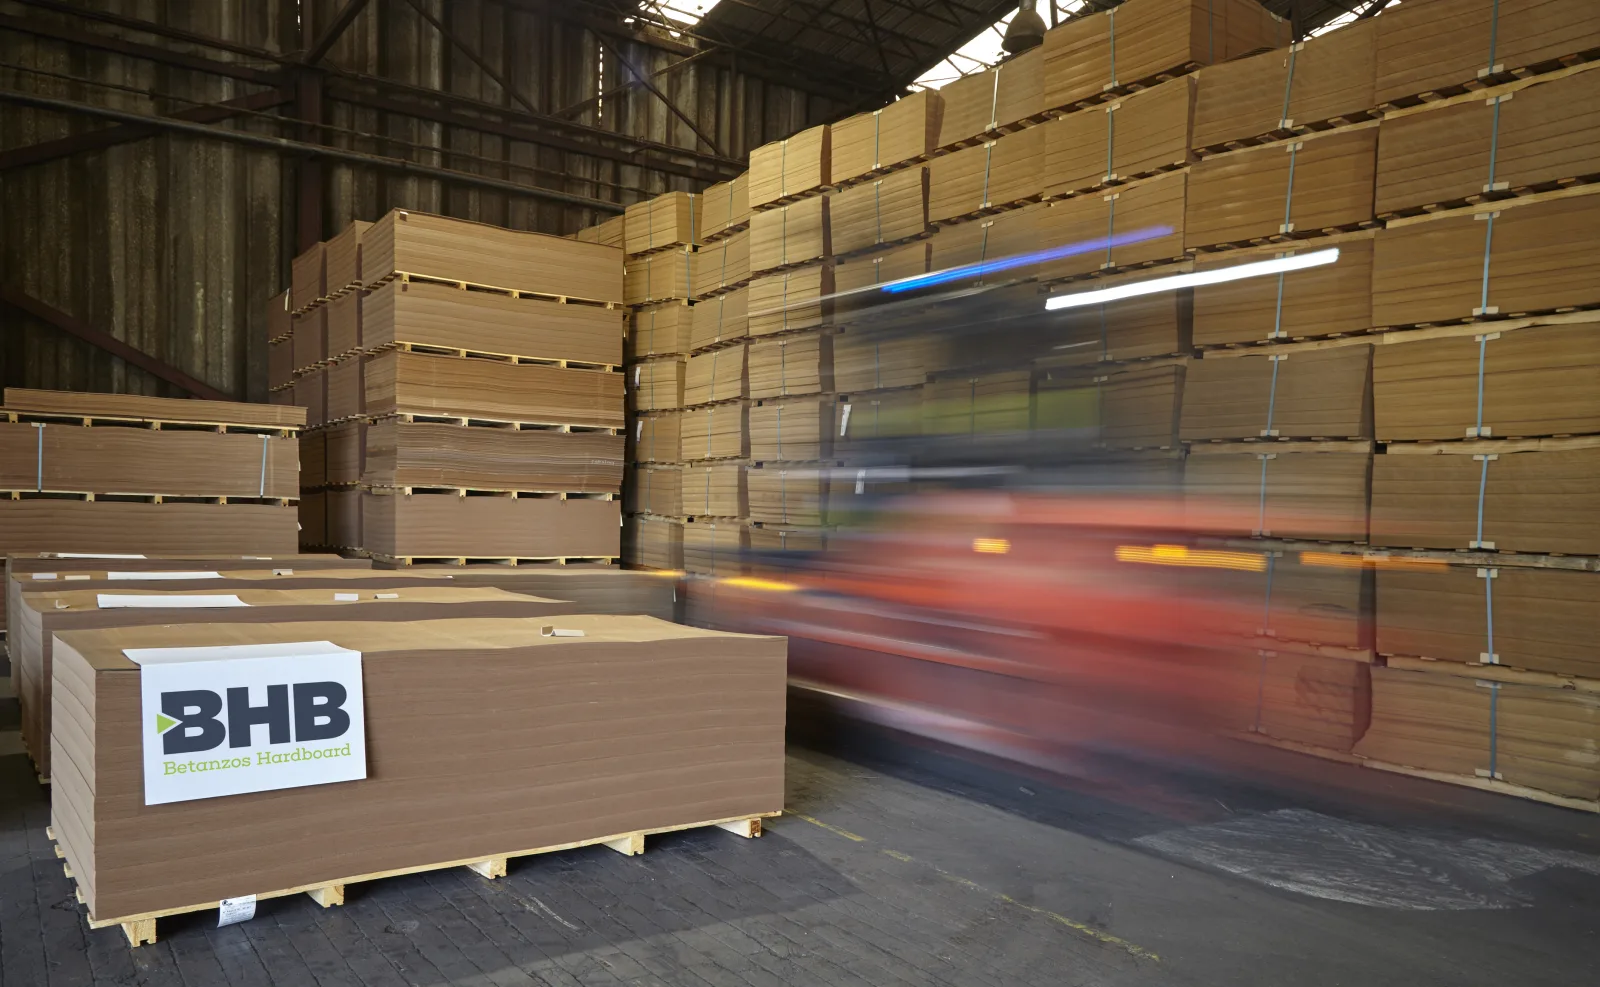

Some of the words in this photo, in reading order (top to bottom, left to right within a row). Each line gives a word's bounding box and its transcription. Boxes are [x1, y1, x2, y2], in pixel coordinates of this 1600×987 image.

[161, 681, 350, 755] BHB
[164, 757, 251, 775] Betanzos
[256, 743, 351, 765] Hardboard
